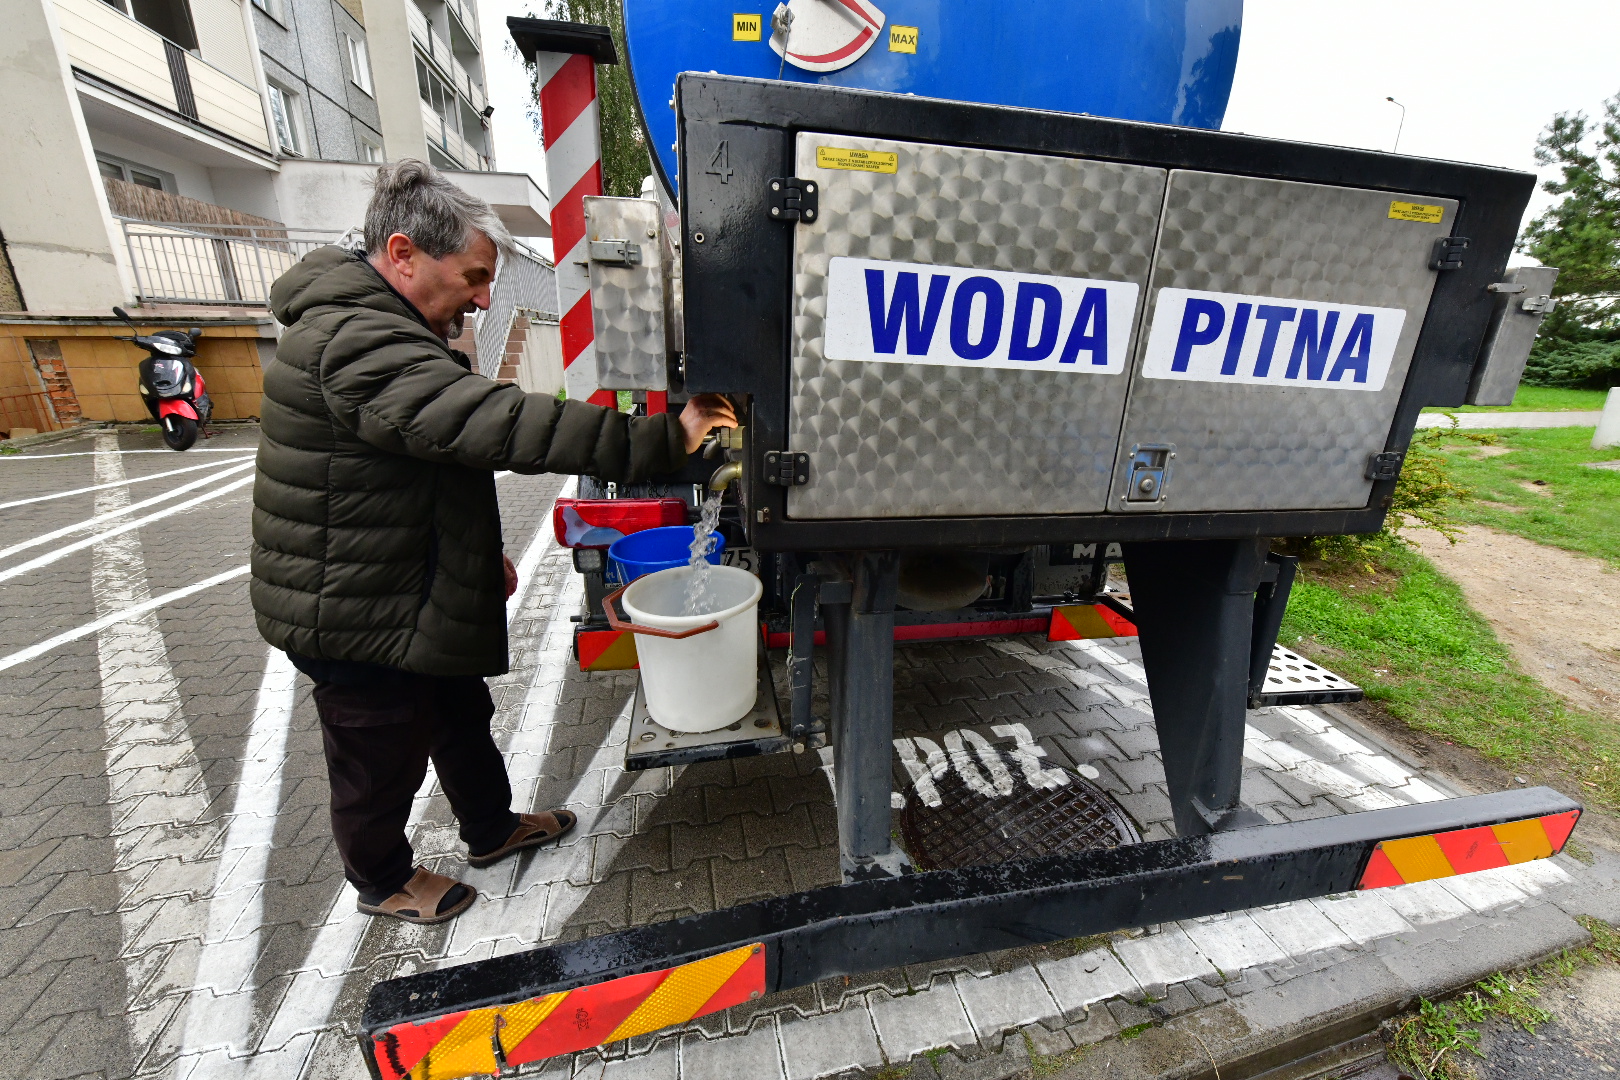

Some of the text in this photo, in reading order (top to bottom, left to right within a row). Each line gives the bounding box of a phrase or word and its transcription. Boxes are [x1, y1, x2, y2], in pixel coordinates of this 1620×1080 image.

[736, 21, 757, 32] MIN
[891, 32, 916, 46] MAX
[704, 139, 734, 185] 4
[849, 151, 869, 159] UWAGA
[863, 268, 1373, 384] WODA PITNA
